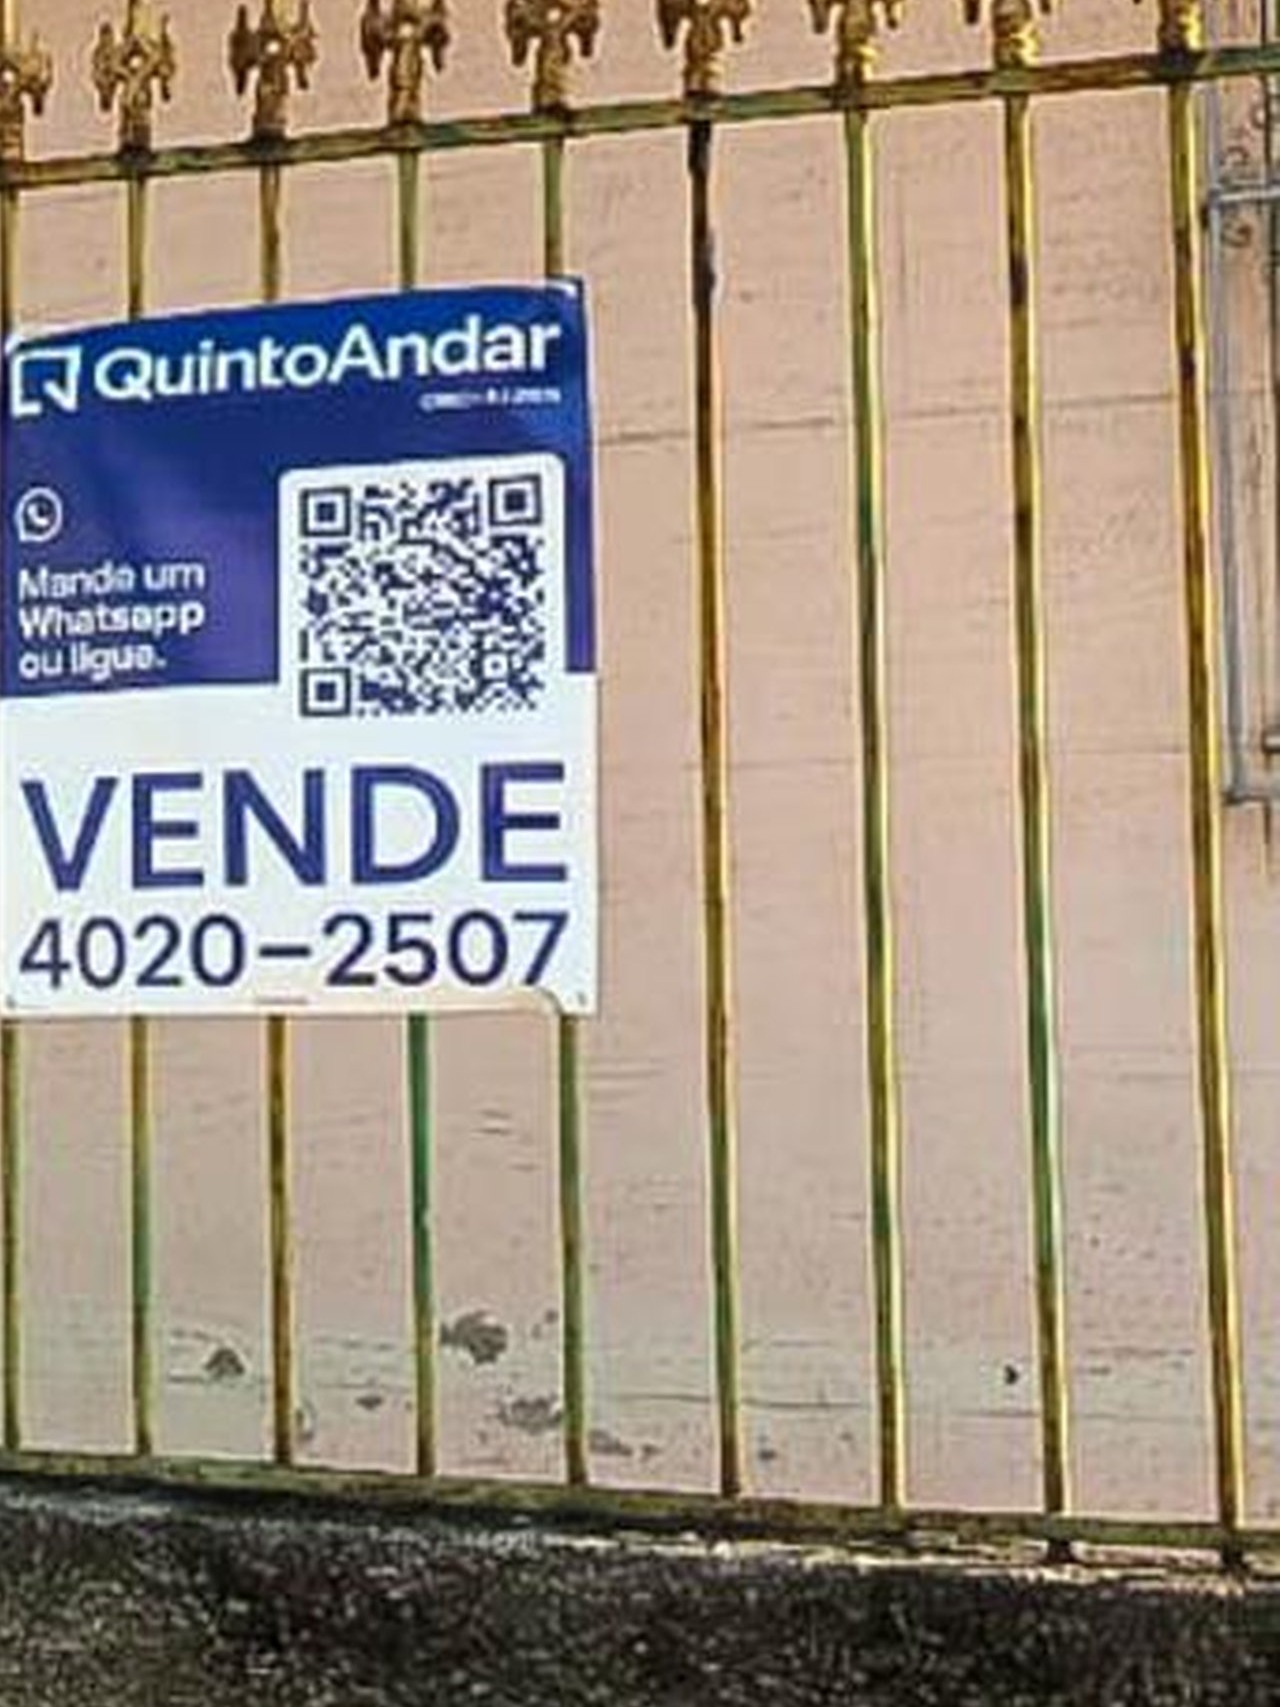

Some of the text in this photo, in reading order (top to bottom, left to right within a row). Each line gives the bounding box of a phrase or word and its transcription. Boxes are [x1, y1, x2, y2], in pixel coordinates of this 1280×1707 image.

[94, 315, 561, 401] QuintoAndar
[143, 562, 206, 592] um
[19, 601, 205, 639] Whatsapp
[19, 651, 63, 680] ou
[19, 761, 568, 892] VENDE
[19, 910, 569, 989] 4020-2507
